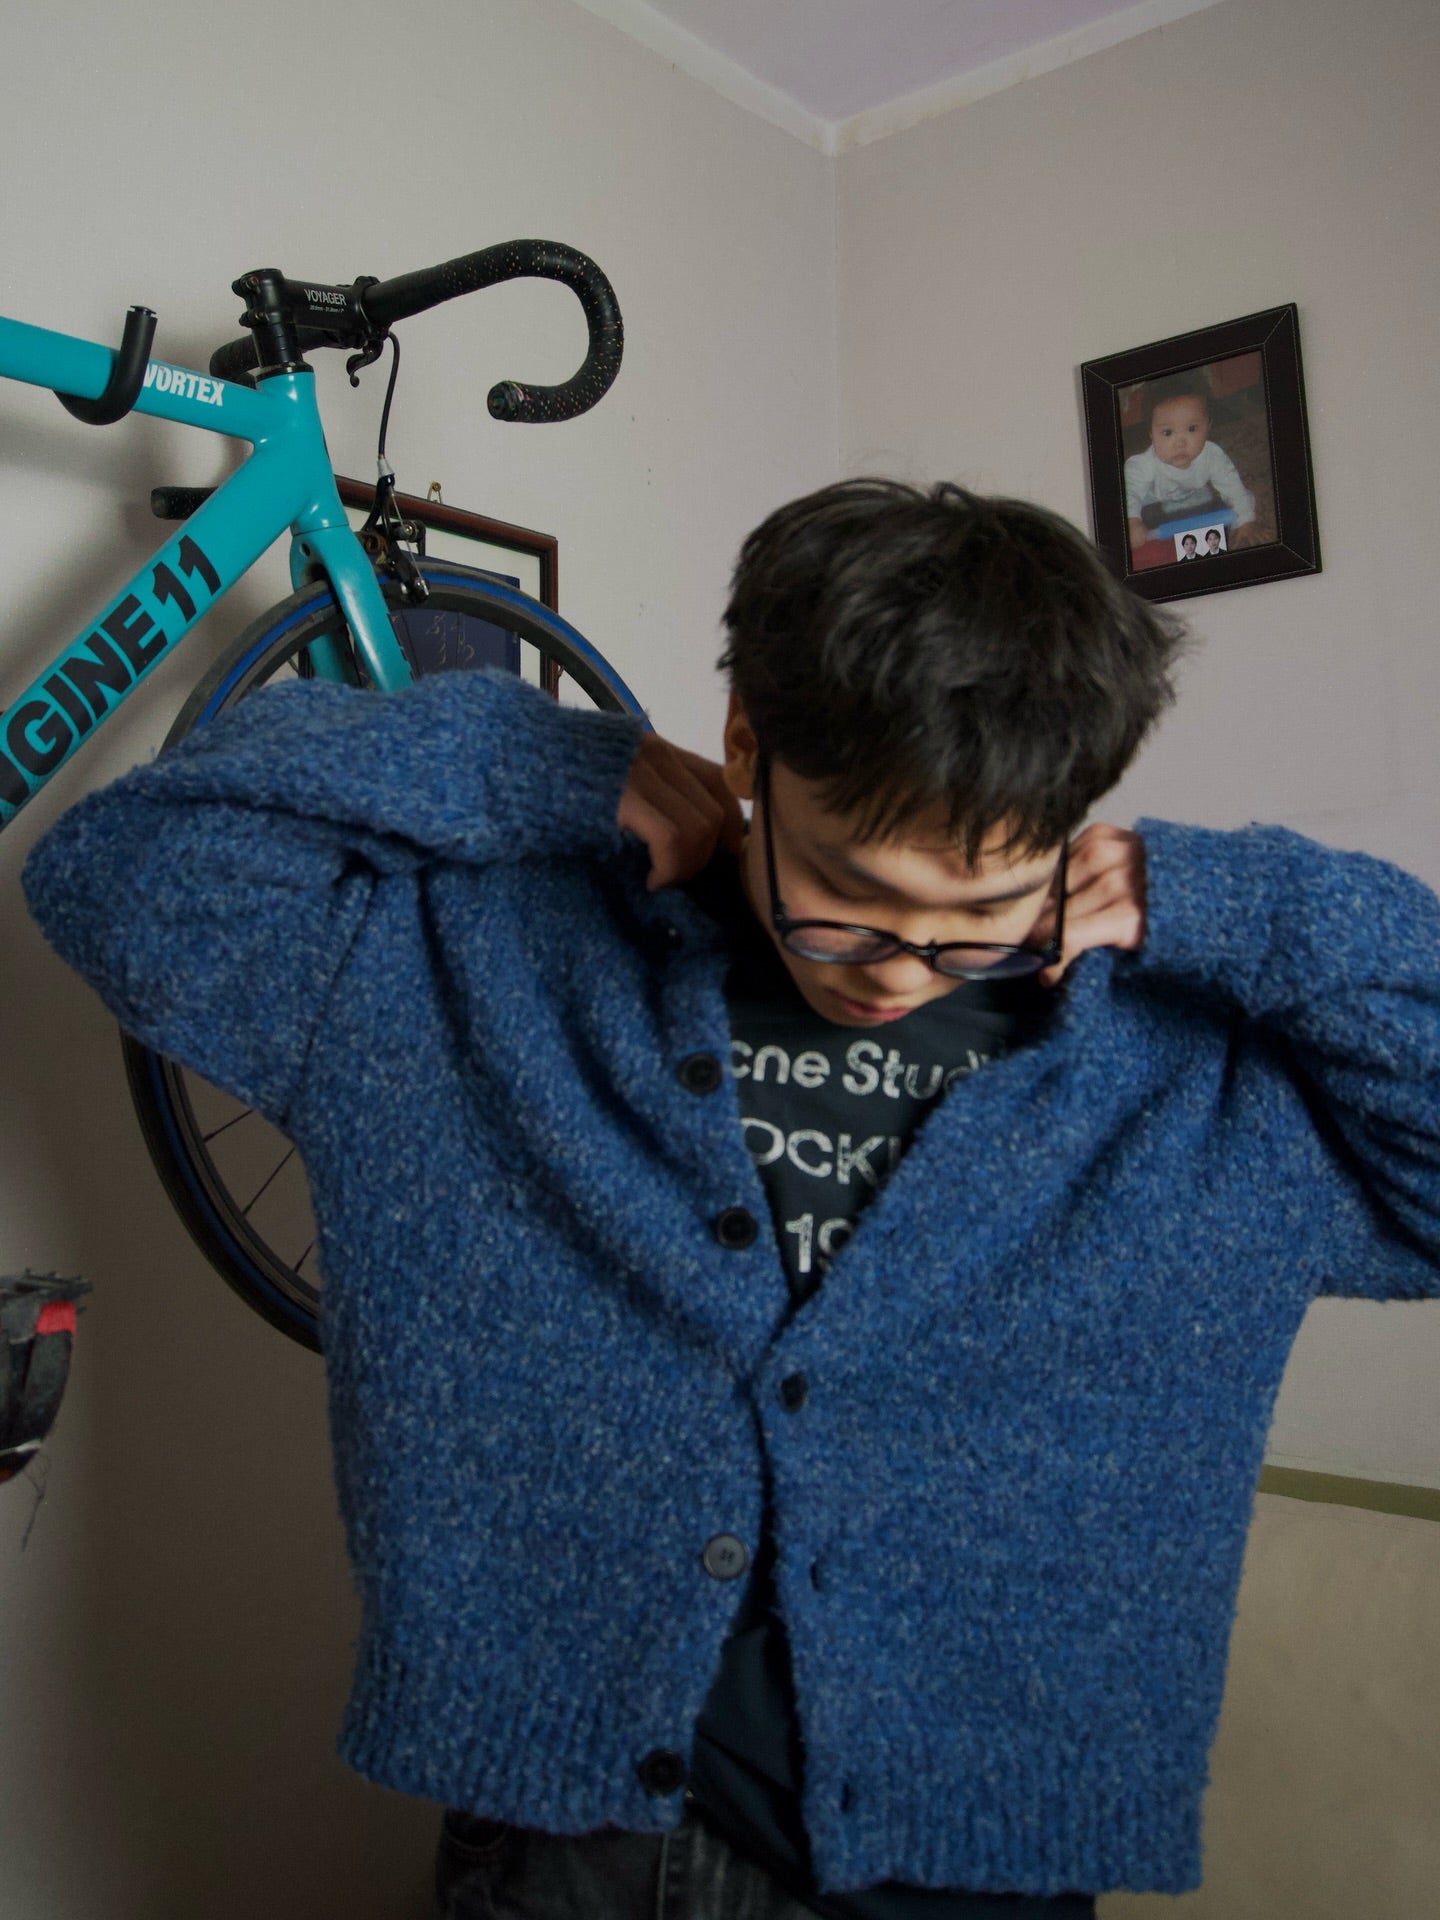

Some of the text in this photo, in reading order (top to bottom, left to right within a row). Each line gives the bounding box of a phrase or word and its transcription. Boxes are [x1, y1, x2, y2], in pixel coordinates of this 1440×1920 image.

[304, 288, 347, 306] VOYAGER
[143, 363, 225, 406] VORTEX
[740, 1117, 901, 1188] OCK
